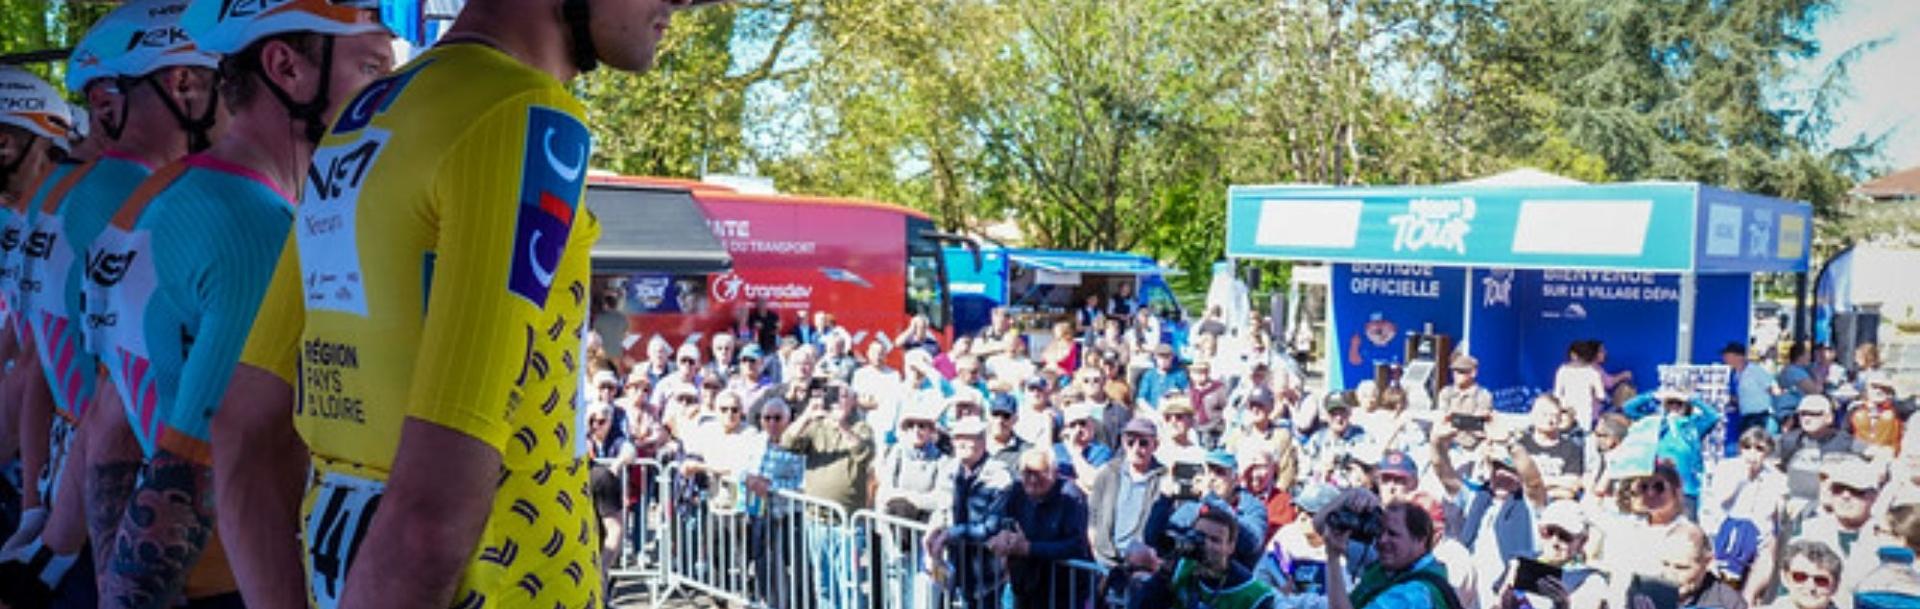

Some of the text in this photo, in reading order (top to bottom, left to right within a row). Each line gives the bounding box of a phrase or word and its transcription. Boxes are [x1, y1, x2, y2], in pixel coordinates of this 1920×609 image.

[1388, 213, 1471, 254] TOUR
[750, 241, 816, 253] TRANSPORT
[744, 284, 813, 298] transdev
[1350, 277, 1441, 298] OFFICIELLE
[1543, 284, 1568, 297] SUR
[1570, 285, 1585, 298] LE
[1587, 286, 1640, 300] VILLAGE
[305, 338, 360, 369] RÉGION
[320, 394, 366, 425] LOIRE
